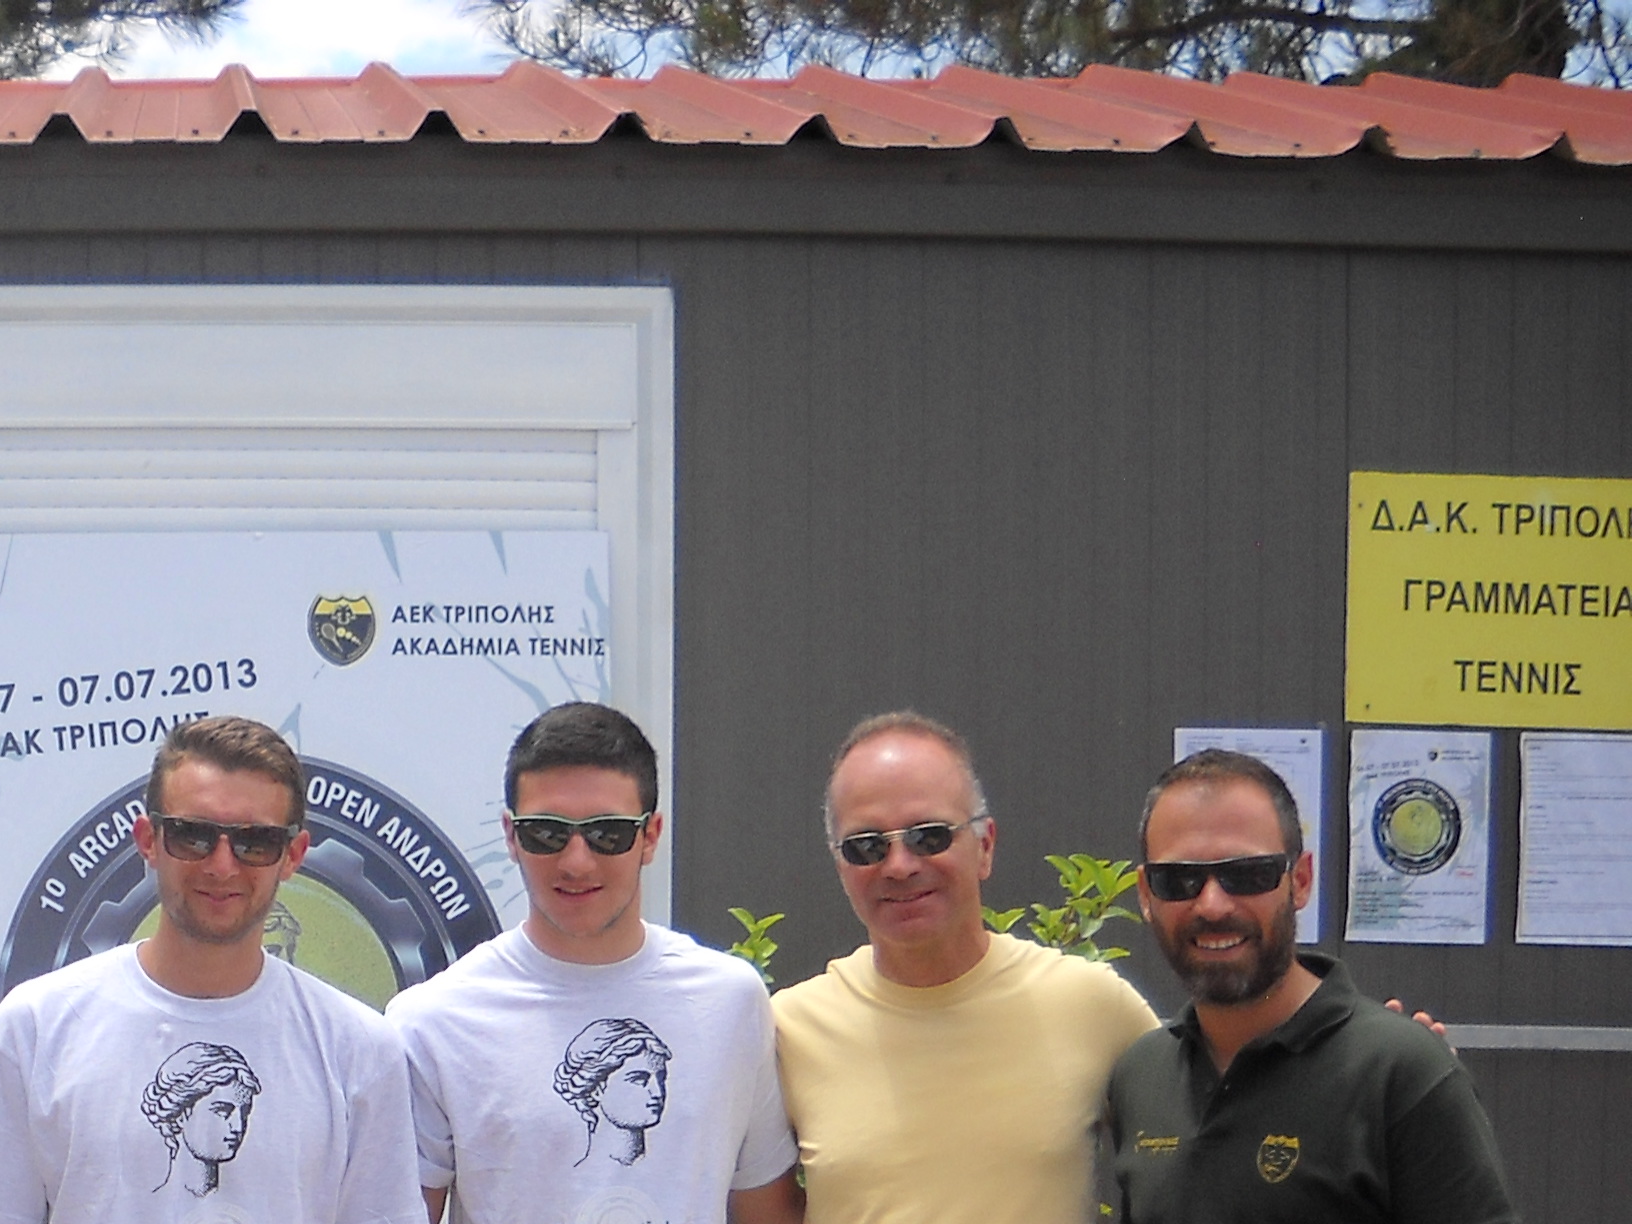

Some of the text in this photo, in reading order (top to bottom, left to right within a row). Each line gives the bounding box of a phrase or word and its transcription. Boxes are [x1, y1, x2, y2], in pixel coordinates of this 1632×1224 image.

[1371, 499, 1632, 539] Δ.Α.Κ. ΤΡΙΠΟΛ
[391, 604, 555, 624] ΑΕΚ ΤΡΙΠΟΛΗΣ
[1404, 579, 1632, 618] ΓΡΑΜΜΑΤΕΙΑ
[391, 636, 606, 656] ΑΚΑΔΗΜΙΑ ΤΕΝΝΙΣ
[57, 657, 259, 708] 07.07.2013
[1454, 660, 1583, 695] ΤΕΝΝΙΣ
[52, 710, 210, 753] ΤΡΙΠΟΛ
[68, 792, 148, 879] ARCAD
[306, 775, 382, 830] OPEN
[377, 815, 470, 922] ΑΝΔΡΩΝ
